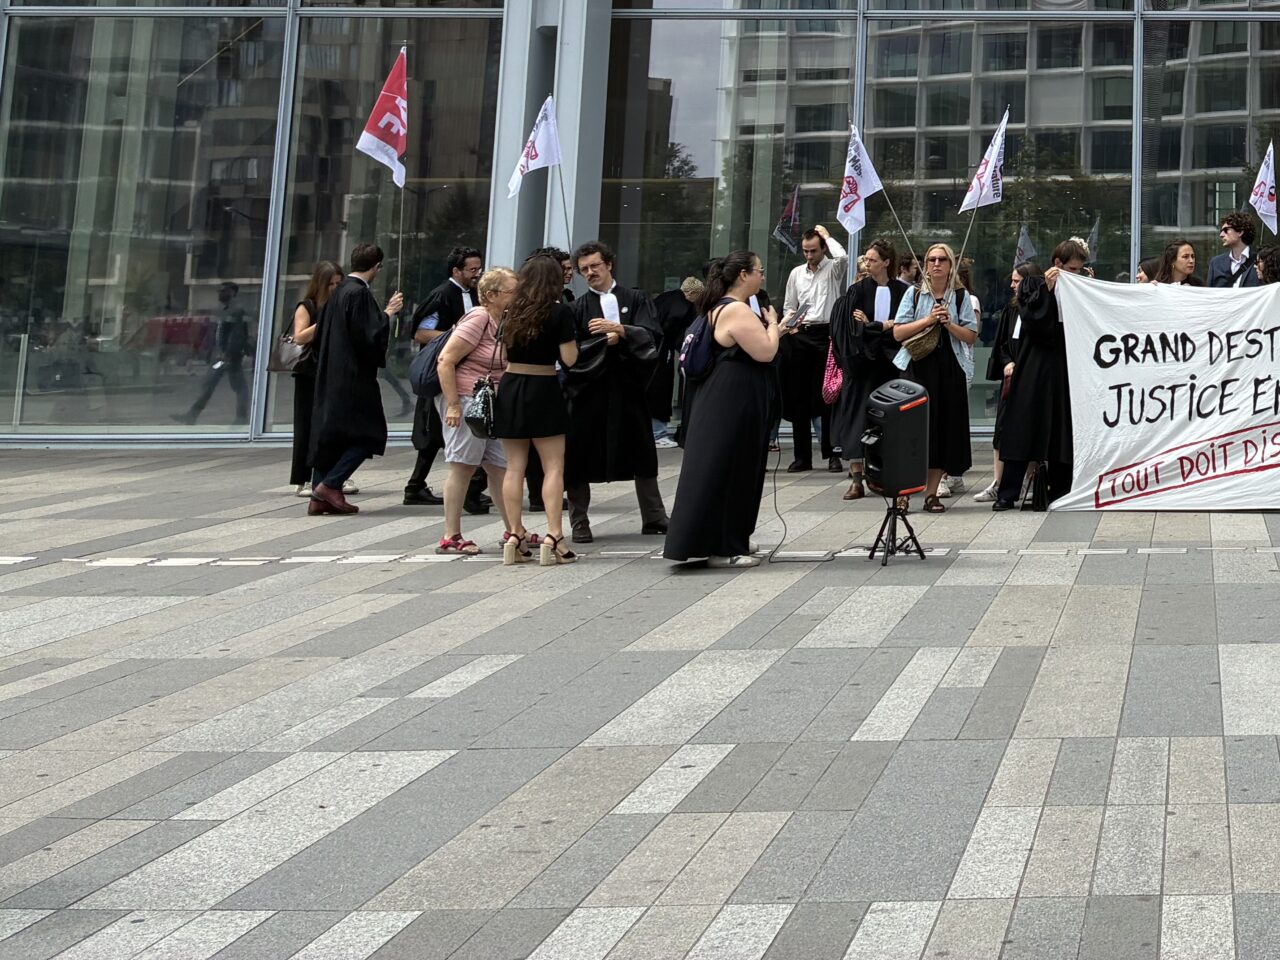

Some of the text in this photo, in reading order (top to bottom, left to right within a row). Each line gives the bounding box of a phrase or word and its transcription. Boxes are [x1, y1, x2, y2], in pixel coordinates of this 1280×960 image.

[1093, 331, 1197, 369] GRAND
[1103, 374, 1240, 428] JUSTICE
[1108, 461, 1165, 498] TOUT
[1177, 442, 1235, 482] DOIT
